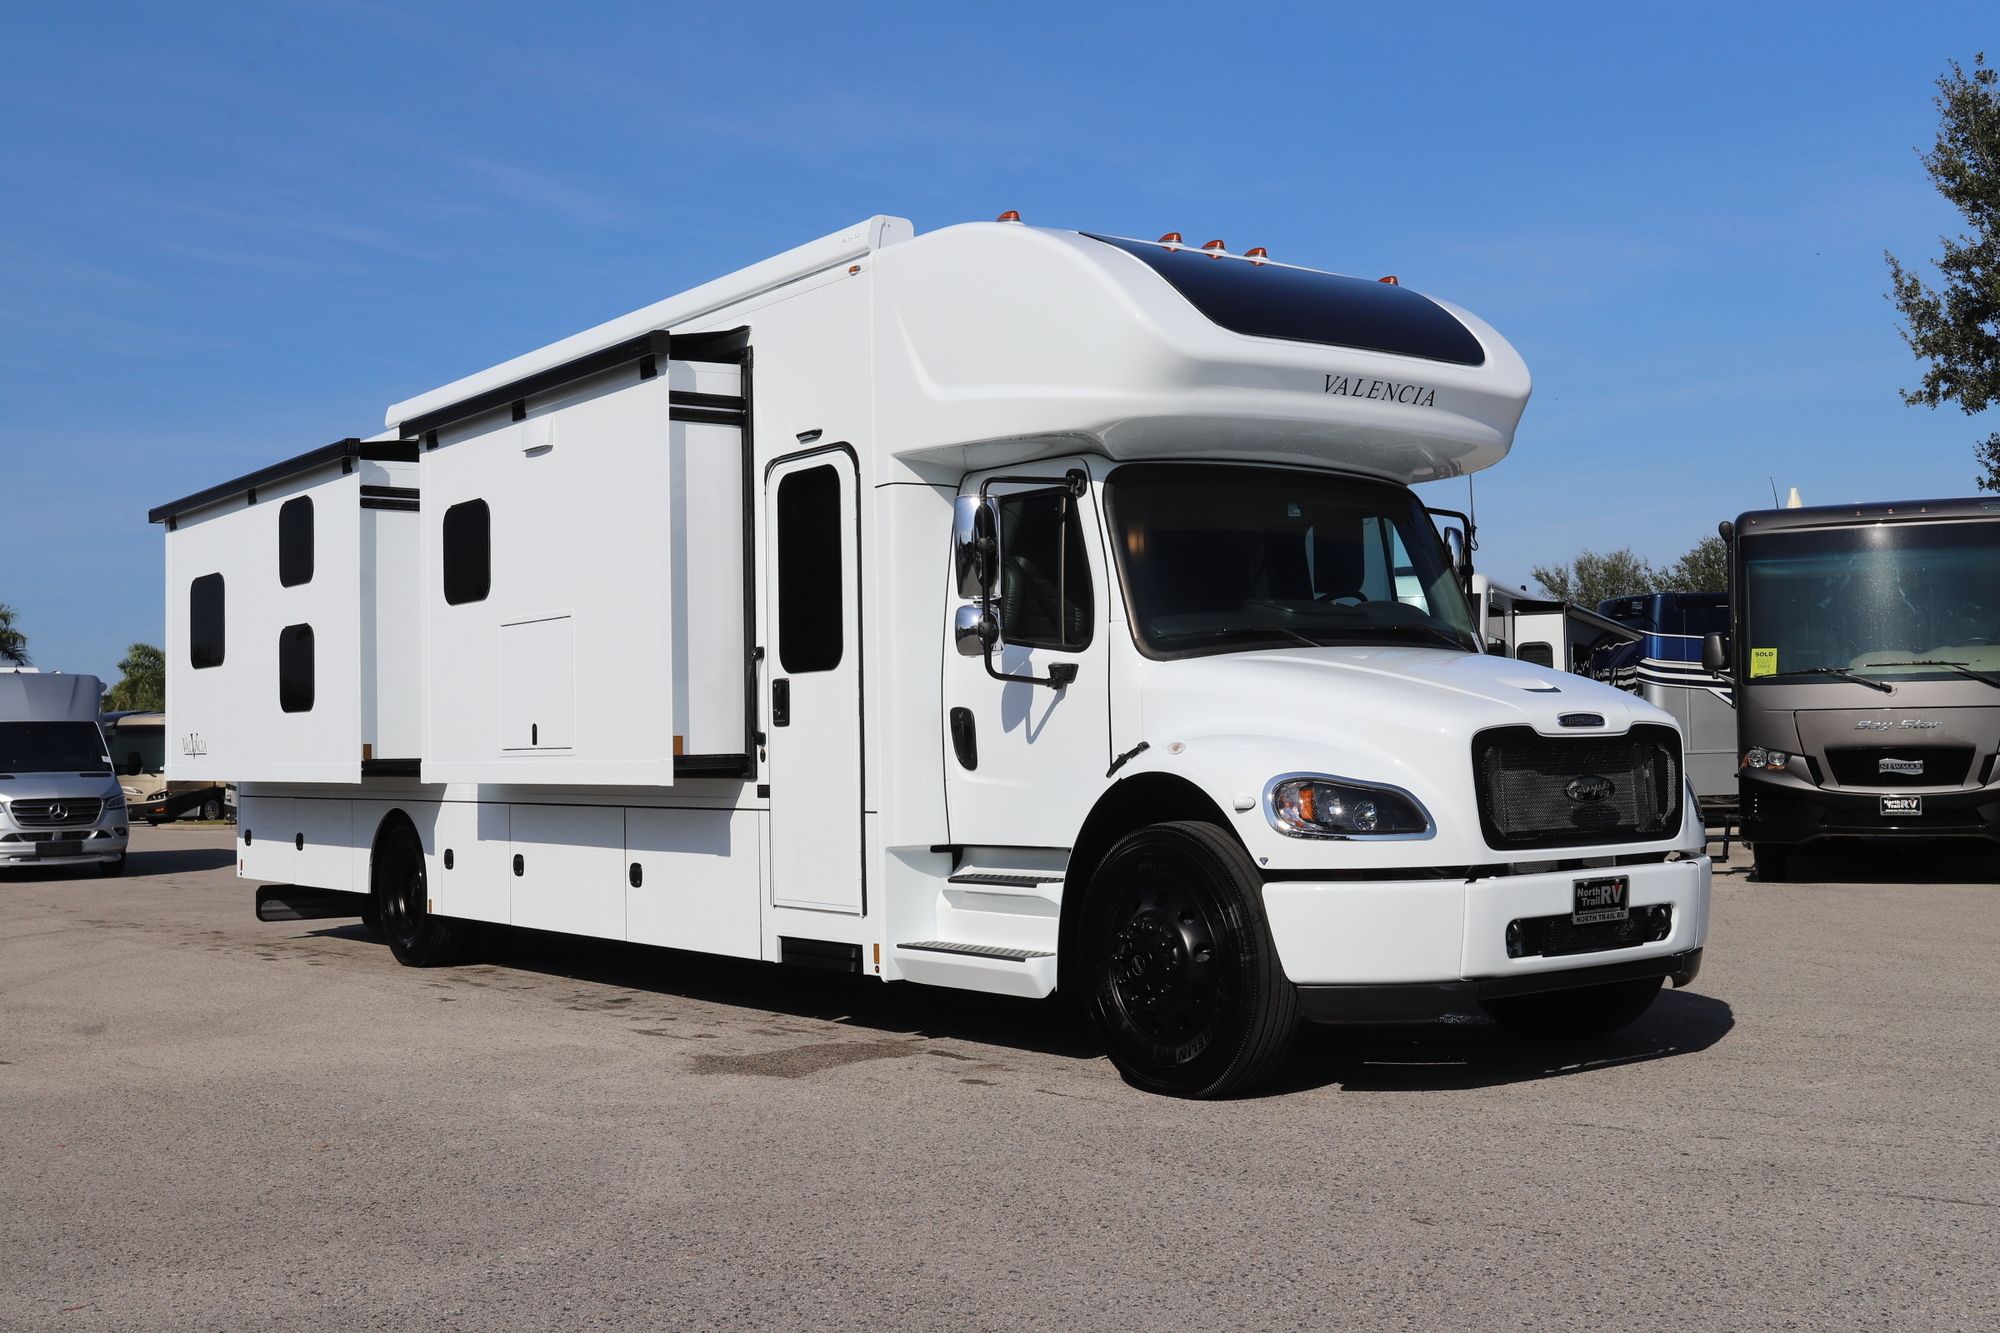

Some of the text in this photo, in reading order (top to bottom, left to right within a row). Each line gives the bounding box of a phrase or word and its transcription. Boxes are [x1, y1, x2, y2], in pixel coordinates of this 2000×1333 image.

[1324, 374, 1436, 407] VALENCIA
[1897, 720, 1942, 729] Star
[1901, 800, 1918, 808] RV
[1577, 887, 1601, 897] North
[1600, 884, 1623, 905] RV
[1581, 896, 1600, 906] Trail
